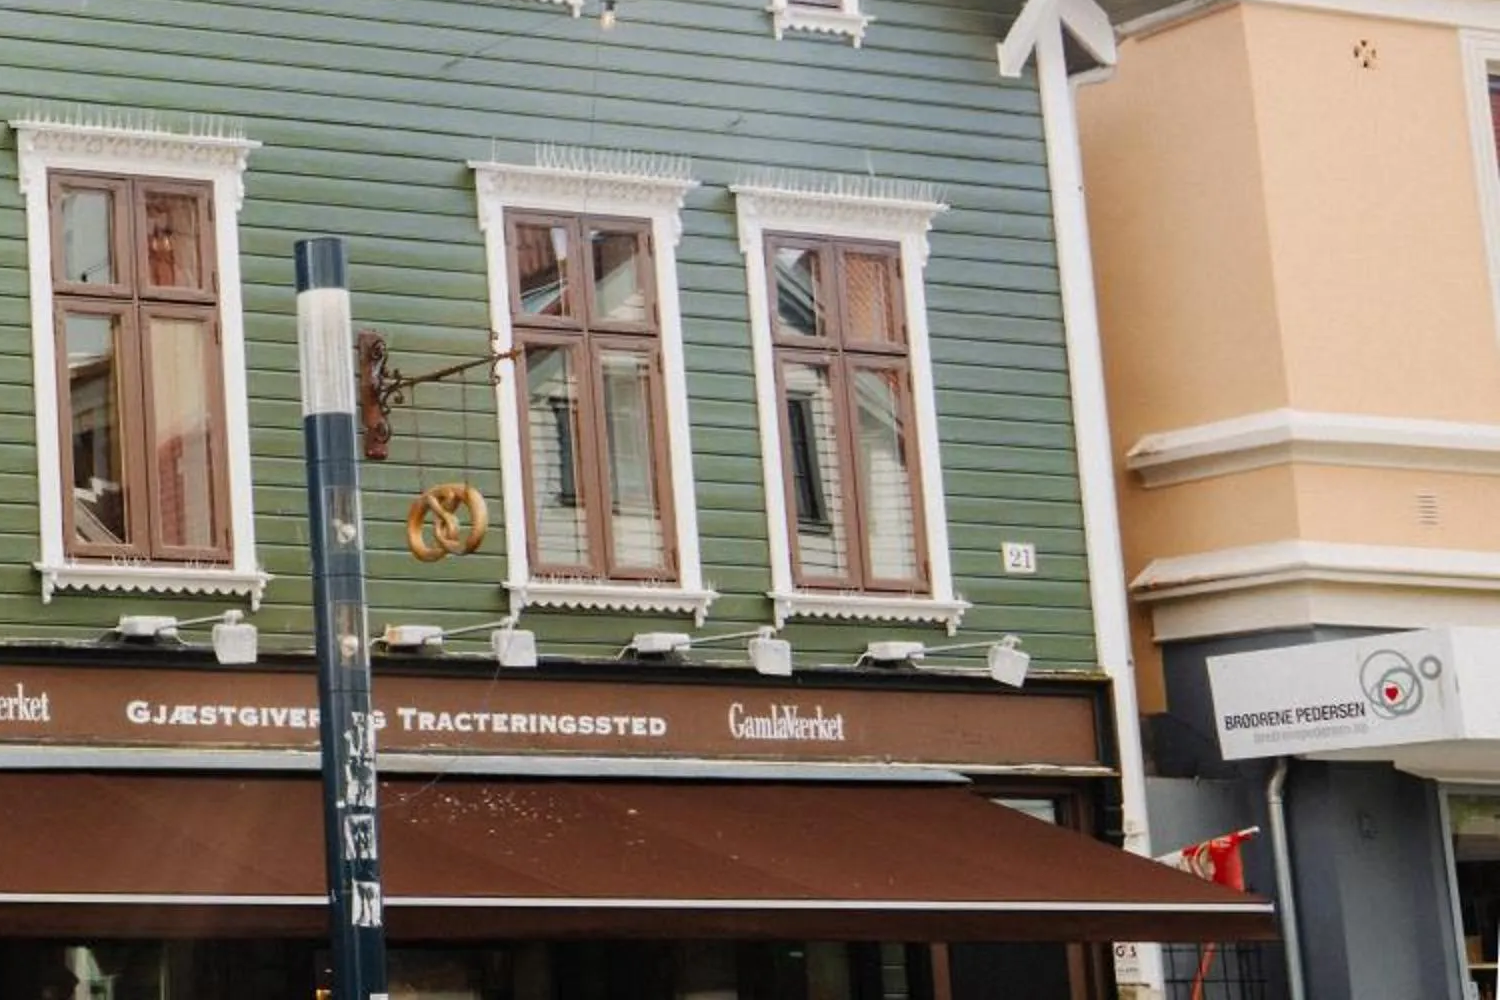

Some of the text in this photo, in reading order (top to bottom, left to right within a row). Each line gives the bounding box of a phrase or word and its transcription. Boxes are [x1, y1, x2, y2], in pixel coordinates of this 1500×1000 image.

[1009, 547, 1032, 569] 21
[126, 700, 320, 728] GJÆSTGIVER
[396, 707, 667, 736] TRACTERINGSSTED
[728, 701, 846, 741] GamlaVærket
[1224, 702, 1365, 730] BRØDRENE PEDERSEN
